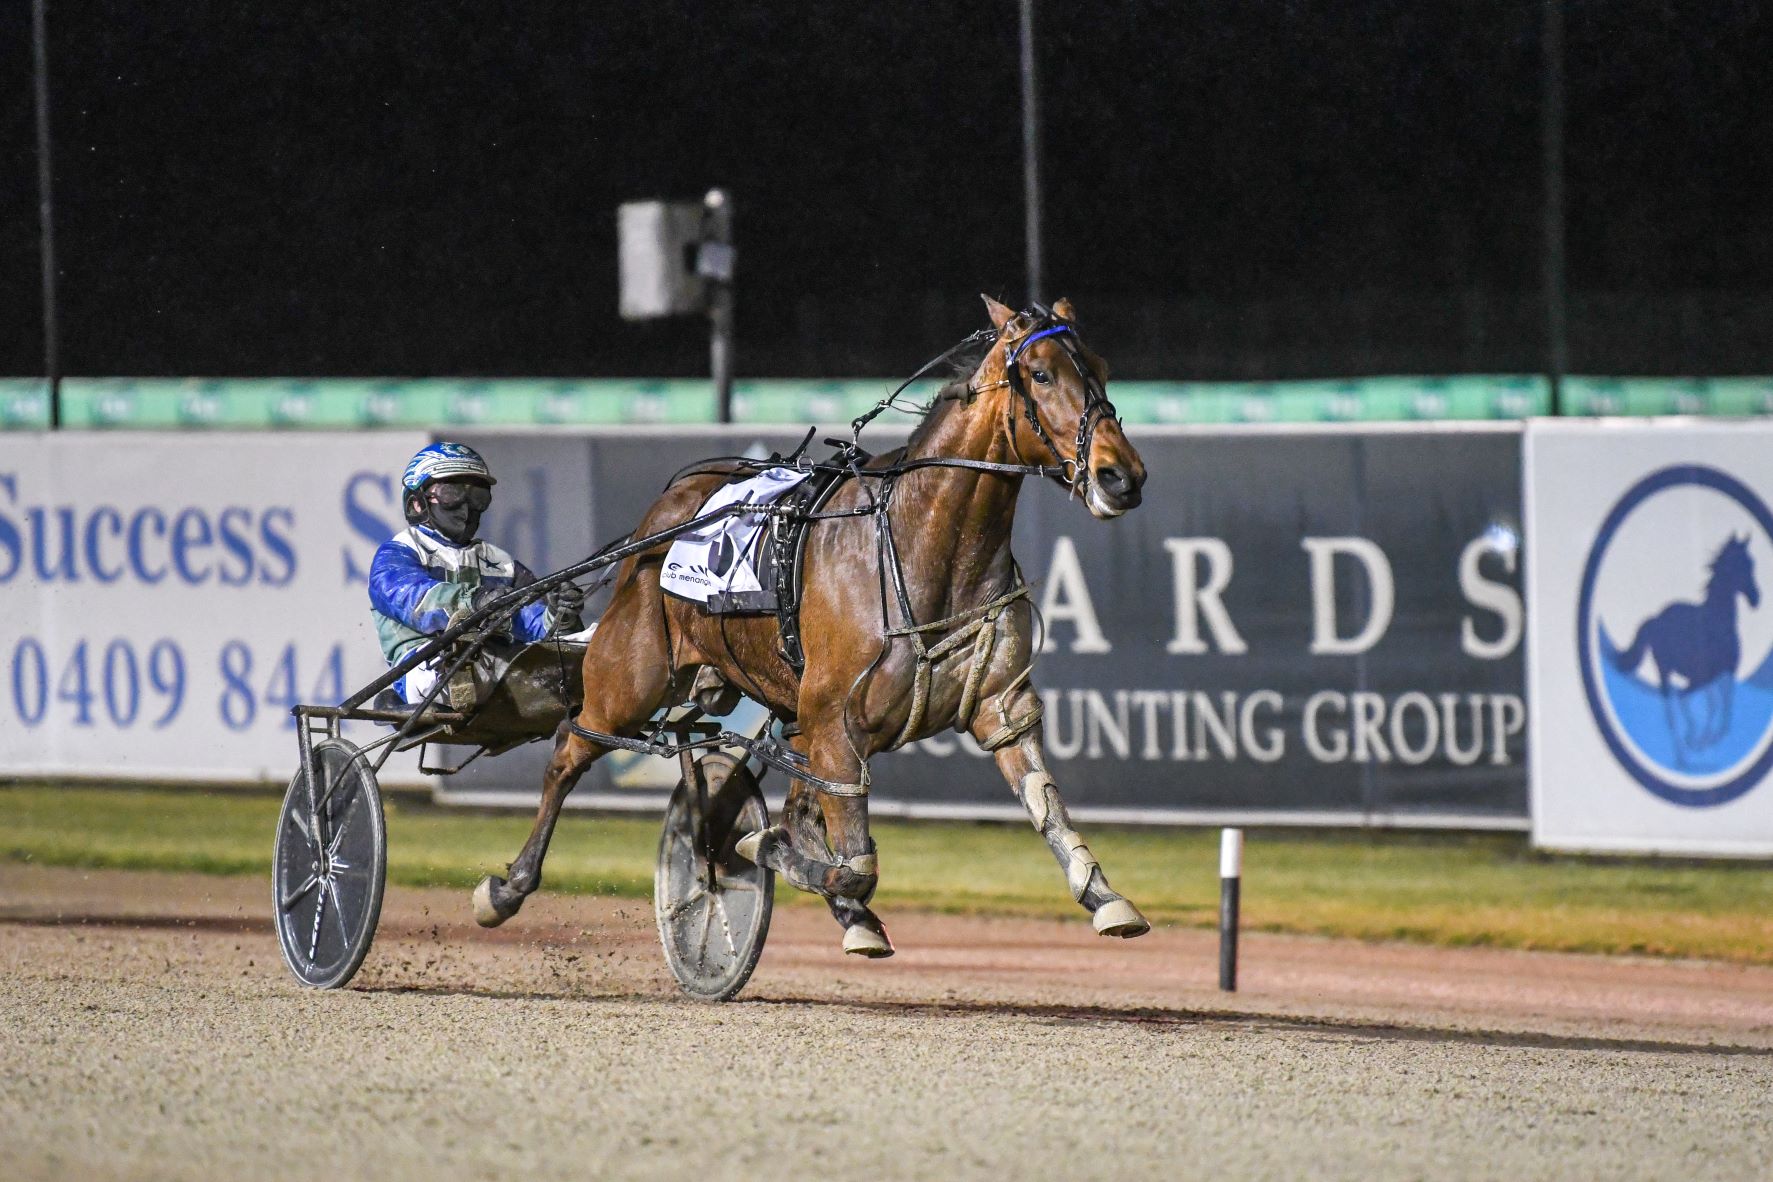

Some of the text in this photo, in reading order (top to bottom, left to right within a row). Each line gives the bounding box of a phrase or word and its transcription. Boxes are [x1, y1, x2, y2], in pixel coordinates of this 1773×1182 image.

[12, 636, 350, 733] 0409 844
[1302, 689, 1525, 766] GROUP
